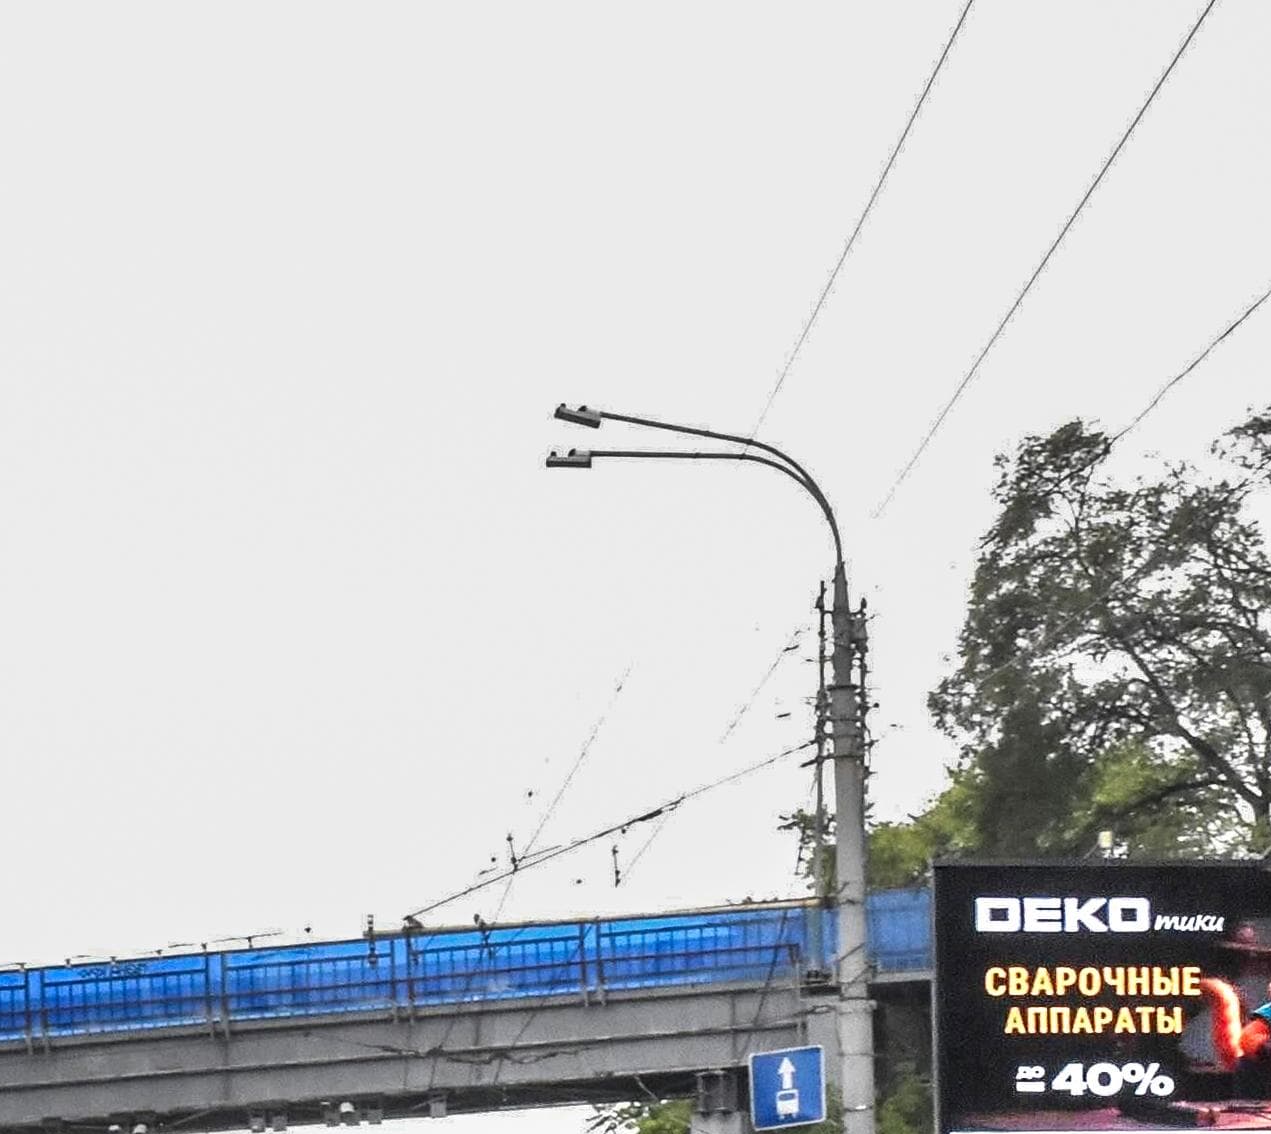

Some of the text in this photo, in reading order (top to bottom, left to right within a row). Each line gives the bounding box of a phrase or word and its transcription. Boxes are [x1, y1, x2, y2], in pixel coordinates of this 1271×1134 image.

[975, 897, 1150, 932] DEKO
[985, 967, 1201, 996] СВАРОЧНЫЕ
[1004, 1007, 1183, 1034] АППАРАТЫ
[1052, 1063, 1175, 1096] 40%
